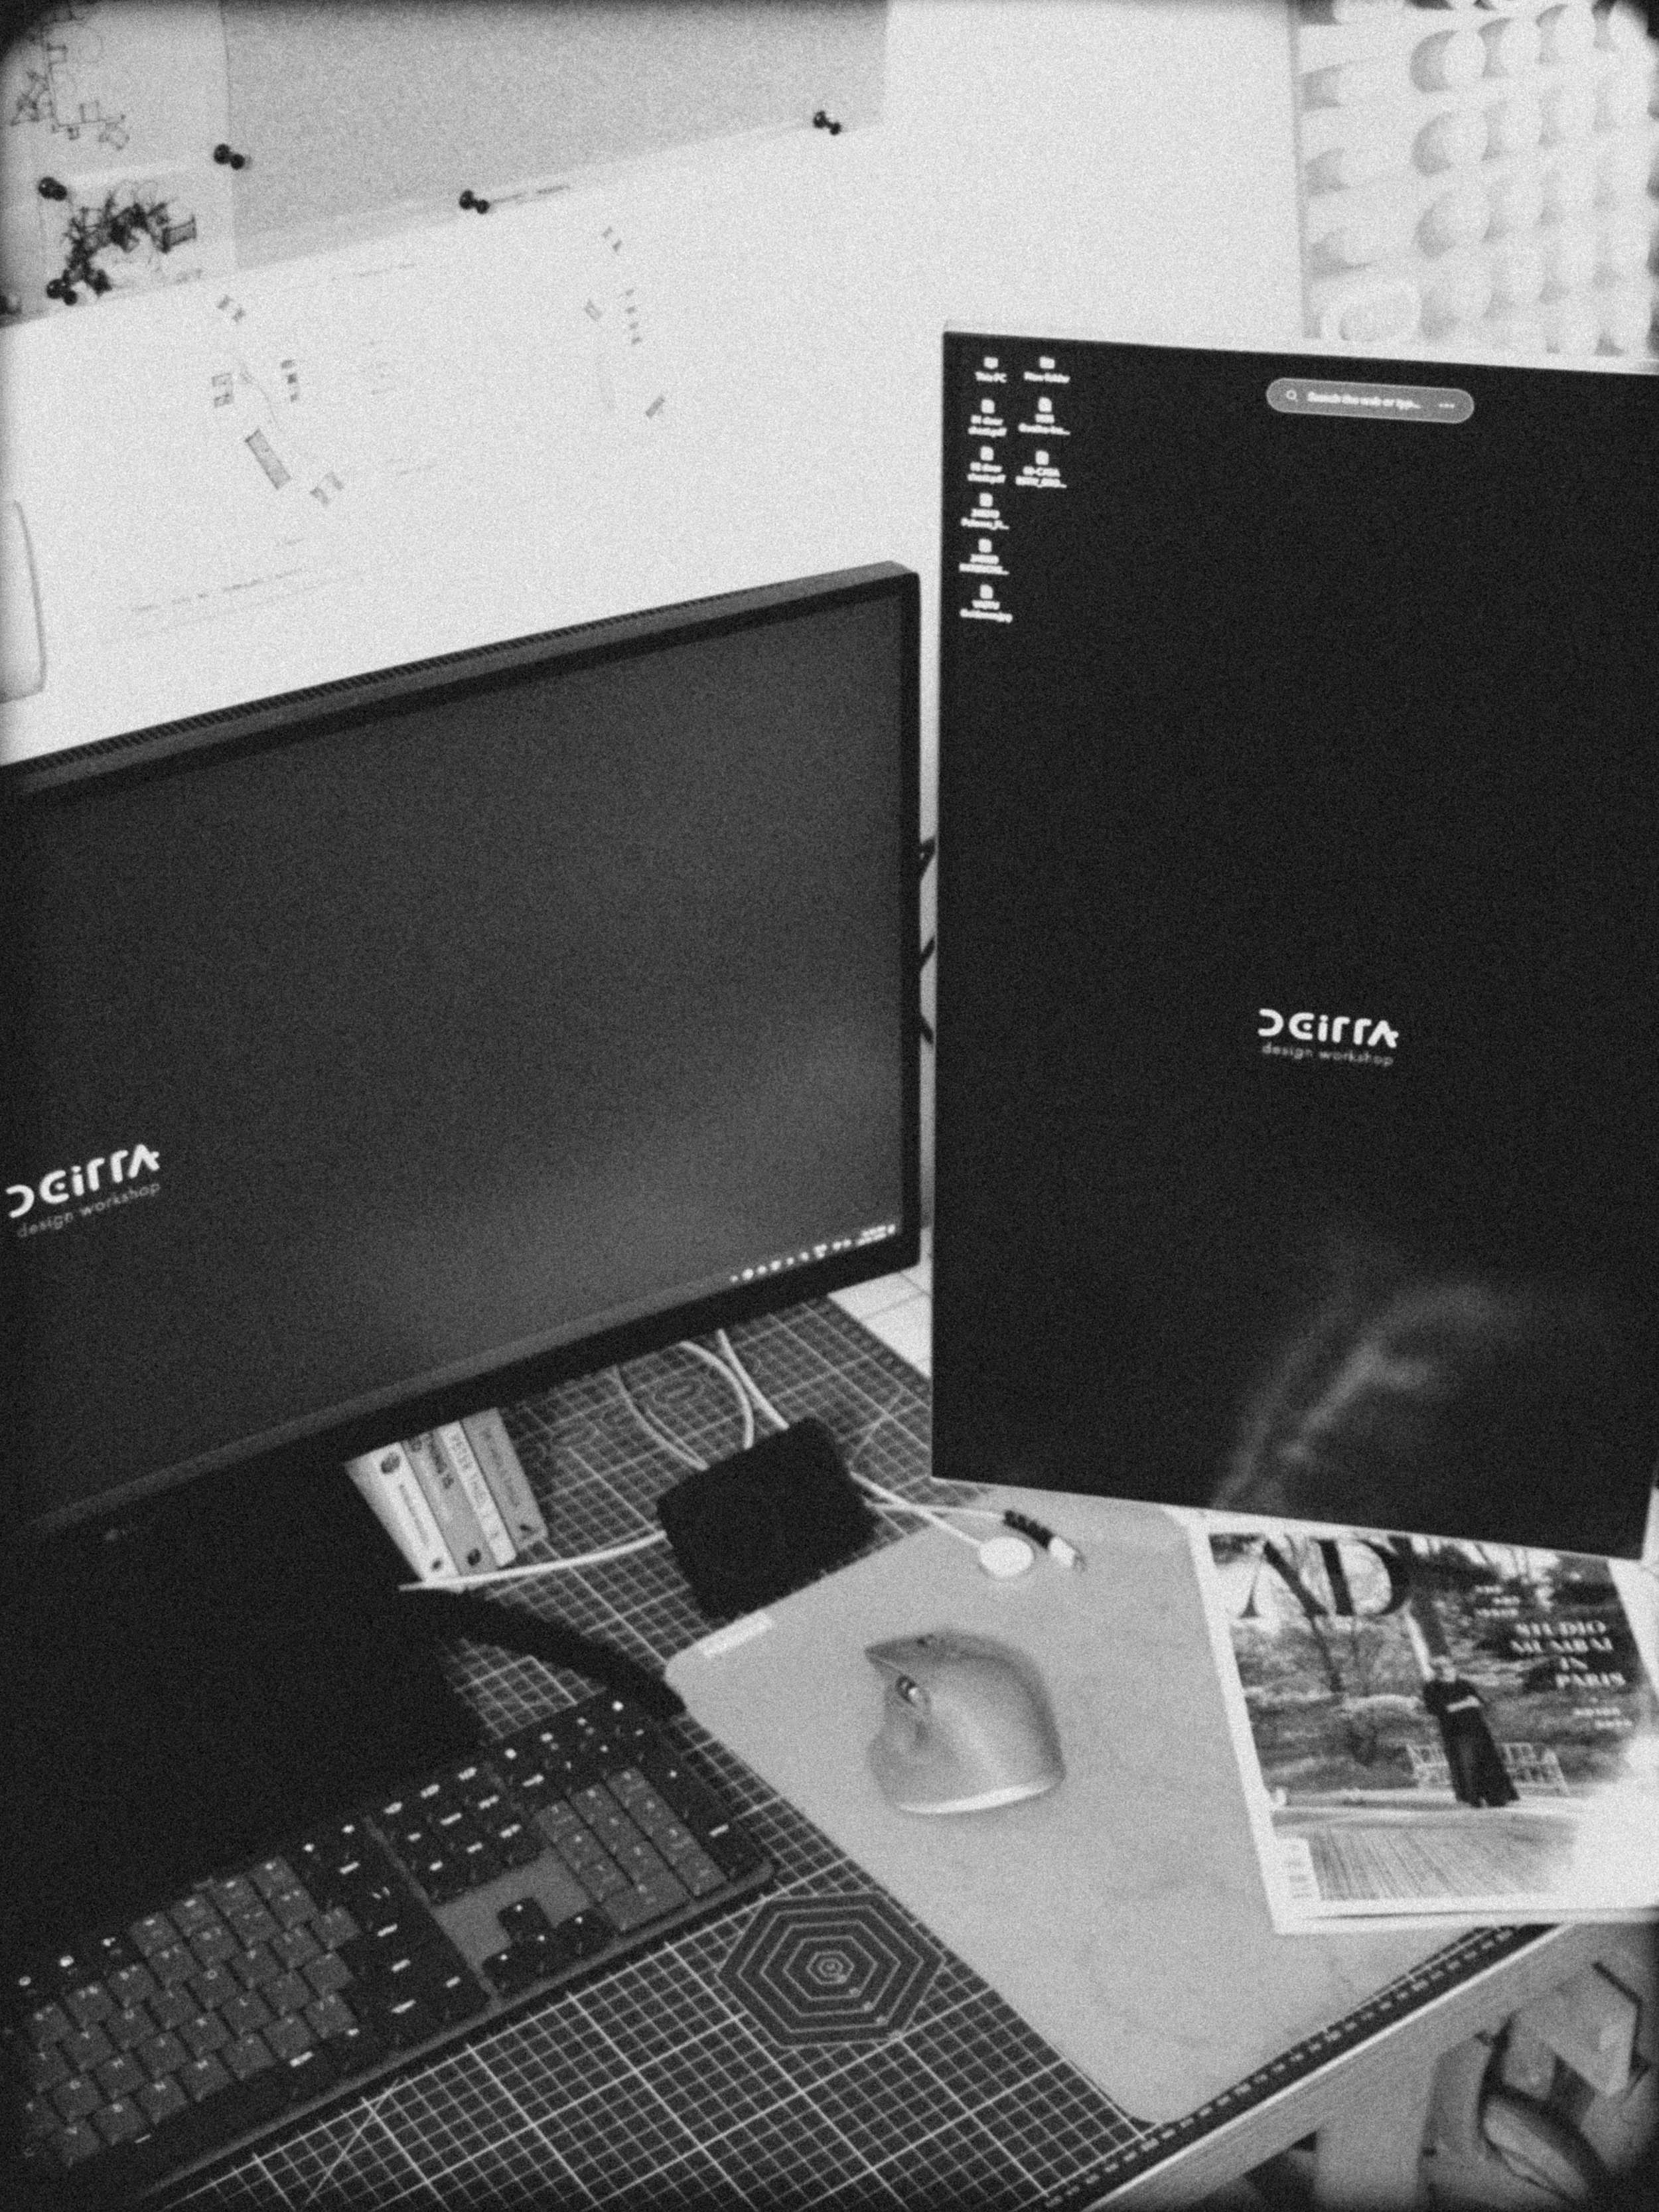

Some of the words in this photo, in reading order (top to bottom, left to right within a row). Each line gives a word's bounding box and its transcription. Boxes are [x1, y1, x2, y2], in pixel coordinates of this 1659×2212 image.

[1262, 1041, 1313, 1060] design
[1318, 1049, 1394, 1068] workshop
[17, 1212, 74, 1238] design
[79, 1183, 161, 1217] workshop
[1239, 1537, 1410, 1618] AD
[1514, 1620, 1607, 1637] STUDIO
[1555, 1672, 1626, 1688] PARIS
